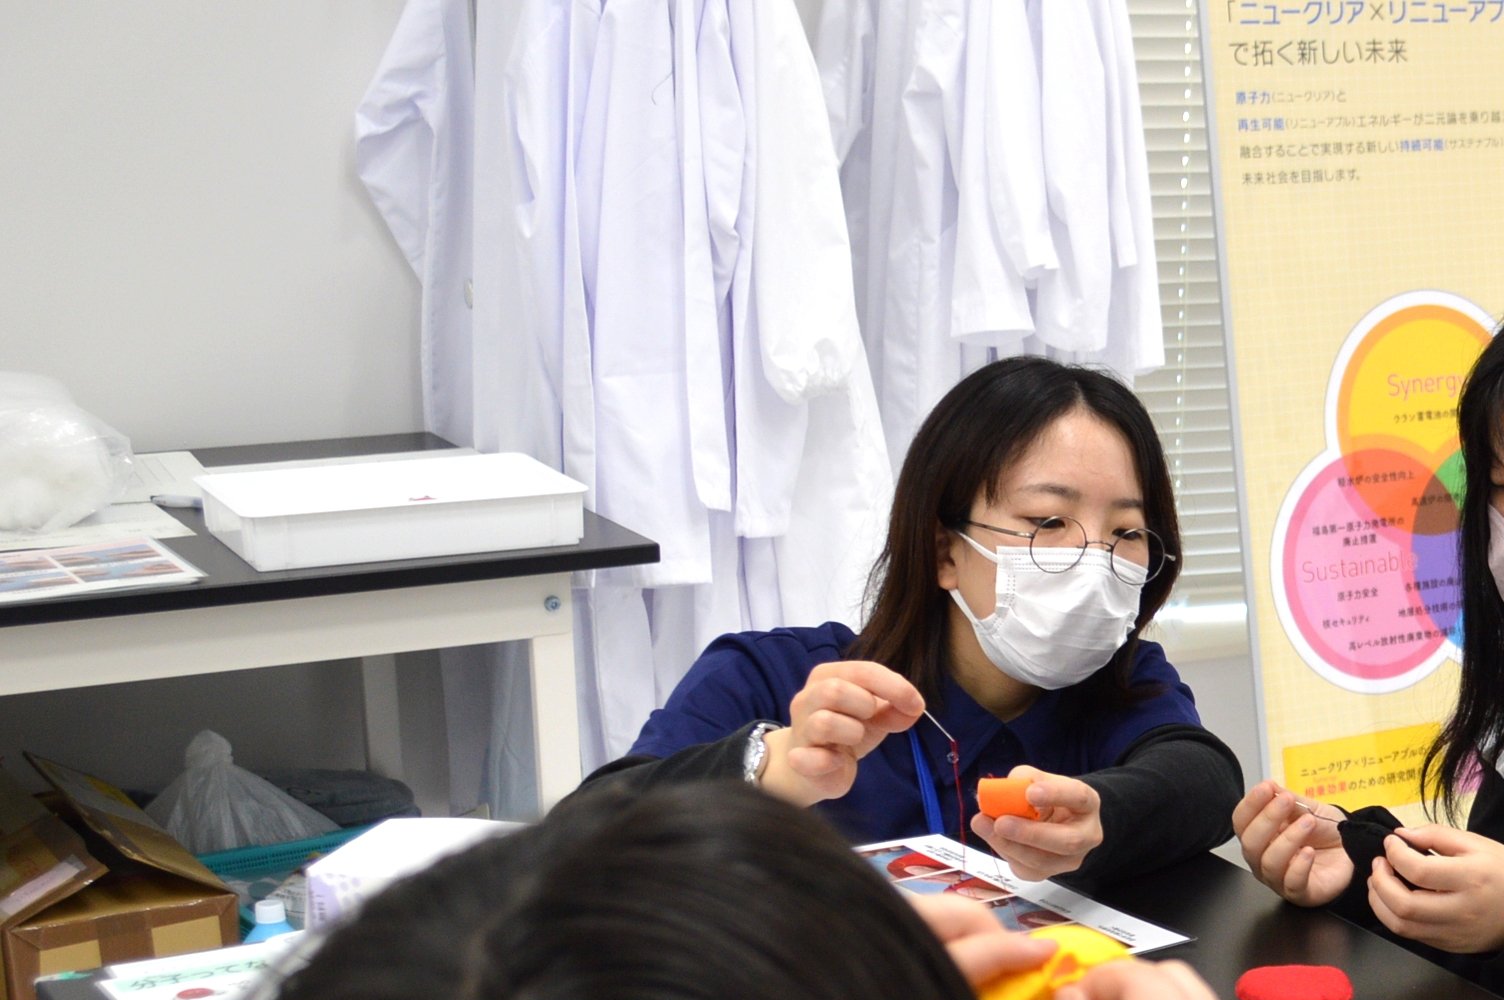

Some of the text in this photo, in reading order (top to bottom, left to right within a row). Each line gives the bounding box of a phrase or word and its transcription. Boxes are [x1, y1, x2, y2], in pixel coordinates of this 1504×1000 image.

[1229, 40, 1408, 66] で拓く新しい未来
[1242, 168, 1361, 185] 未来社会を目指します。
[1337, 587, 1379, 602] 原子力安全
